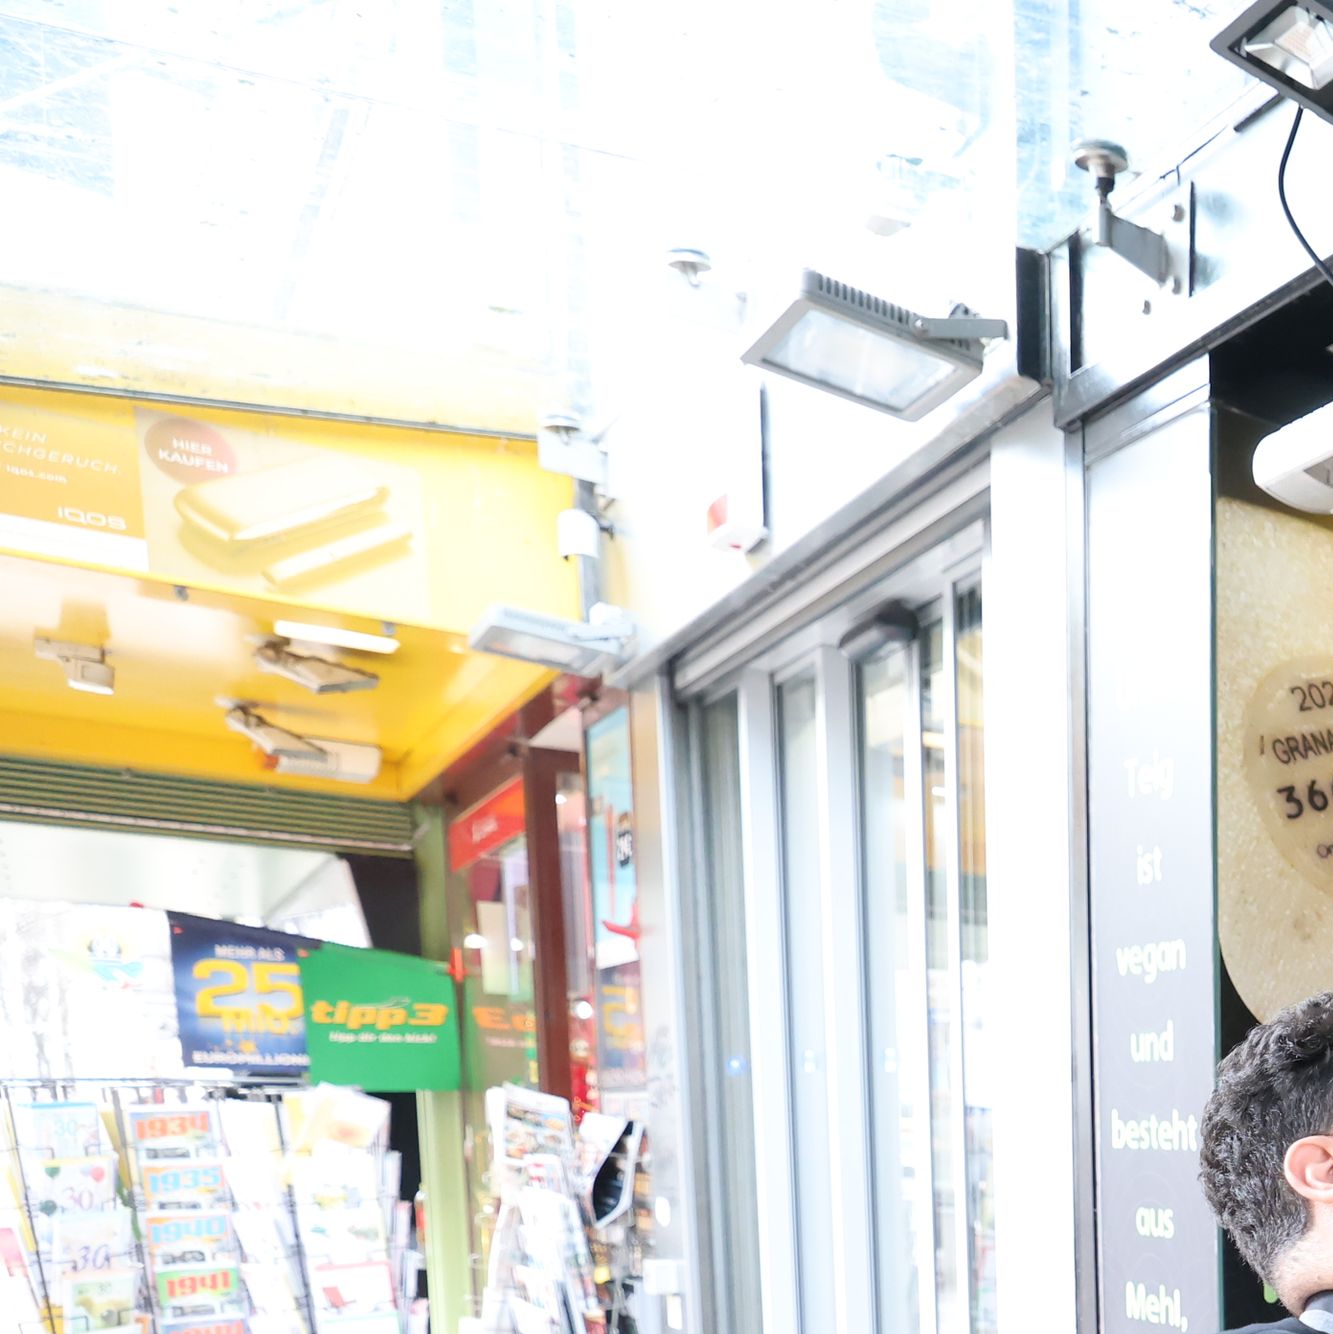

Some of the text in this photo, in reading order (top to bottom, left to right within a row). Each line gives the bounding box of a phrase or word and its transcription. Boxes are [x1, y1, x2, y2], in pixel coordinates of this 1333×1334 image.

[158, 448, 229, 473] KAUFEN
[172, 437, 212, 457] HIER
[57, 505, 127, 531] IQOS
[1123, 748, 1174, 800] Teig
[1136, 844, 1162, 885] ist
[214, 944, 285, 962] MEHR ALS
[1115, 938, 1186, 984] vegan
[193, 959, 304, 1020] 25
[311, 1000, 448, 1030] tipp3
[1130, 1019, 1174, 1062] und
[136, 1111, 210, 1141] 1934
[1111, 1108, 1198, 1152] besteht
[149, 1167, 221, 1194] 1935
[151, 1218, 226, 1245] 1940
[1136, 1206, 1175, 1239] aus
[167, 1271, 232, 1298] 1941
[1125, 1281, 1188, 1333] Mehl,
